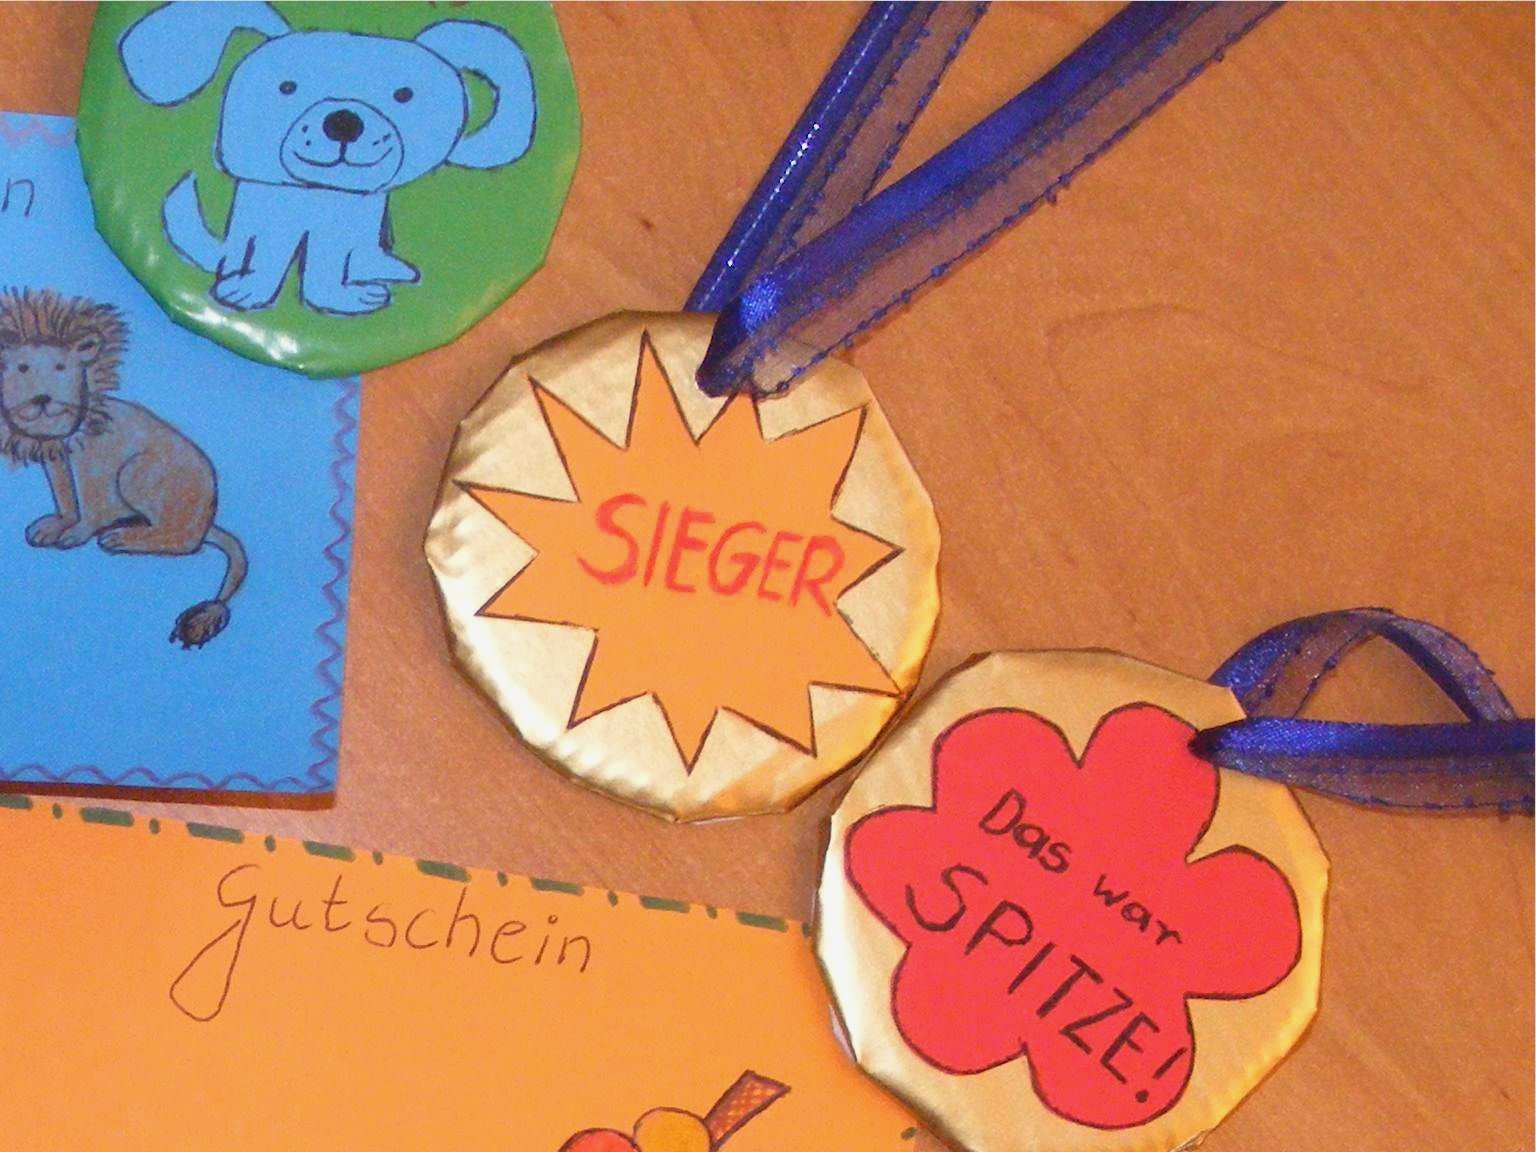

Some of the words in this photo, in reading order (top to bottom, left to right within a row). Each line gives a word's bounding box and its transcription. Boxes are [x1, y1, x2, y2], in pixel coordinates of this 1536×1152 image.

[577, 493, 846, 617] SIEGER
[168, 863, 594, 1022] Gutschein
[977, 787, 1071, 873] Das
[1093, 873, 1184, 947] war
[904, 862, 1188, 1105] SPITZE!
